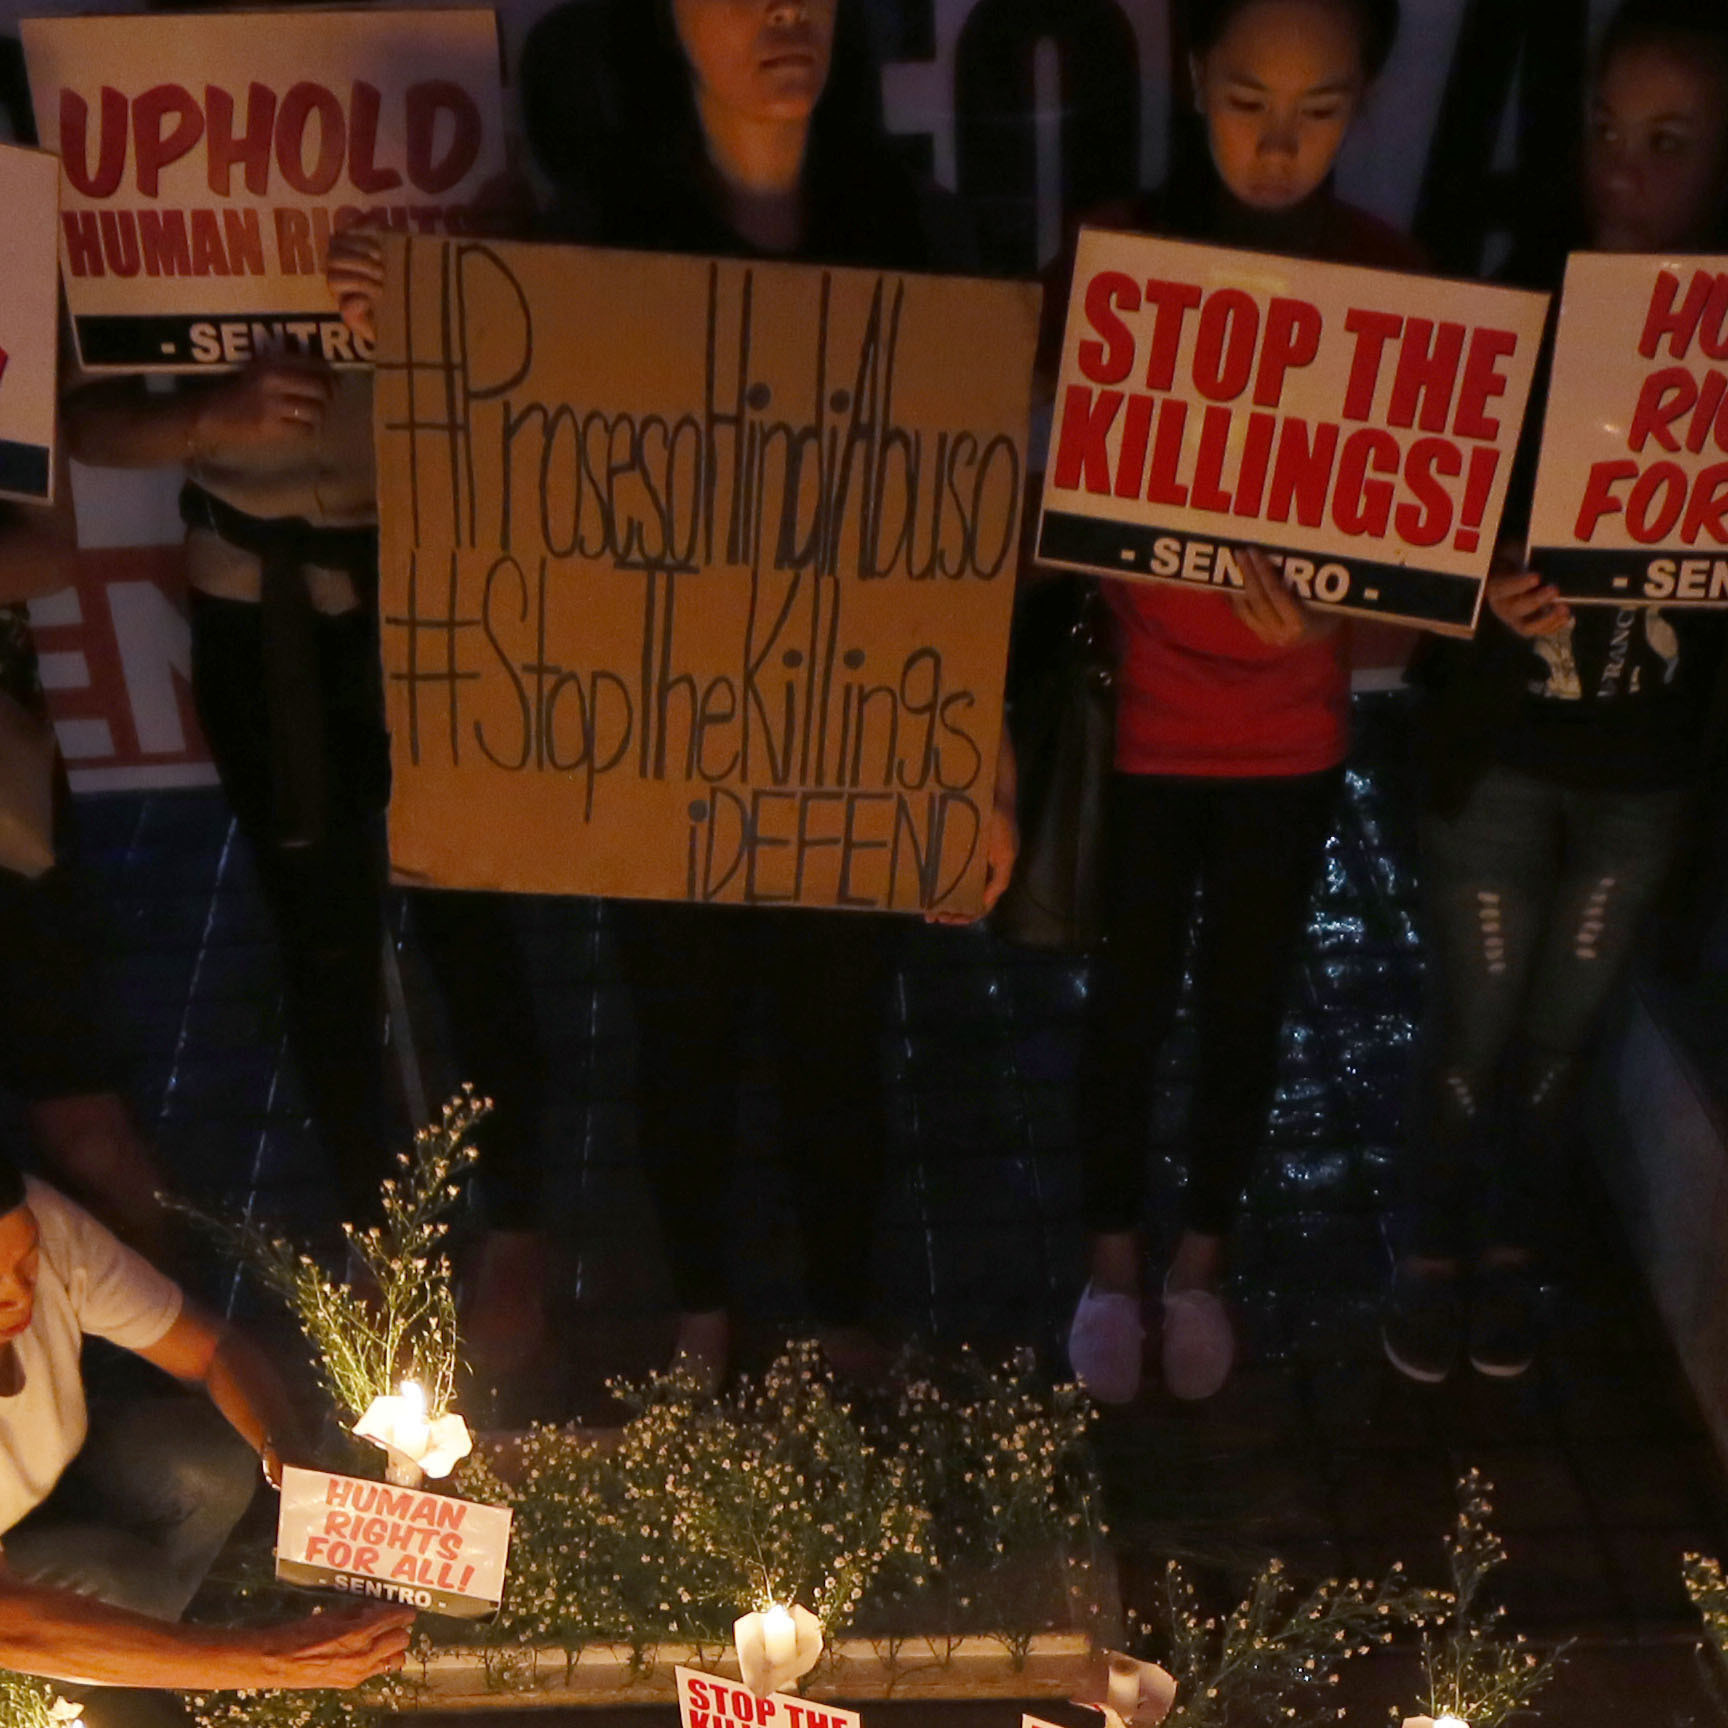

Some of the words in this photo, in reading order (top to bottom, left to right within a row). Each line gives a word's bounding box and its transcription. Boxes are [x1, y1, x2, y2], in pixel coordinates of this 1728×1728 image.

[57, 79, 483, 198] UPHOLD
[60, 208, 266, 278] HUMAN
[1077, 270, 1322, 403] STOP
[1342, 306, 1518, 442] THE
[1053, 384, 1501, 554] KILLINGS!
[384, 549, 983, 826] #StopTheKillings
[685, 788, 982, 911] iDEFEND
[323, 1510, 464, 1562] RIGHTS
[325, 1478, 468, 1531] HUMAN
[304, 1535, 381, 1575] FOR
[389, 1553, 476, 1593] ALL!
[334, 1573, 433, 1609] SENTRO
[687, 1678, 776, 1727] STOP
